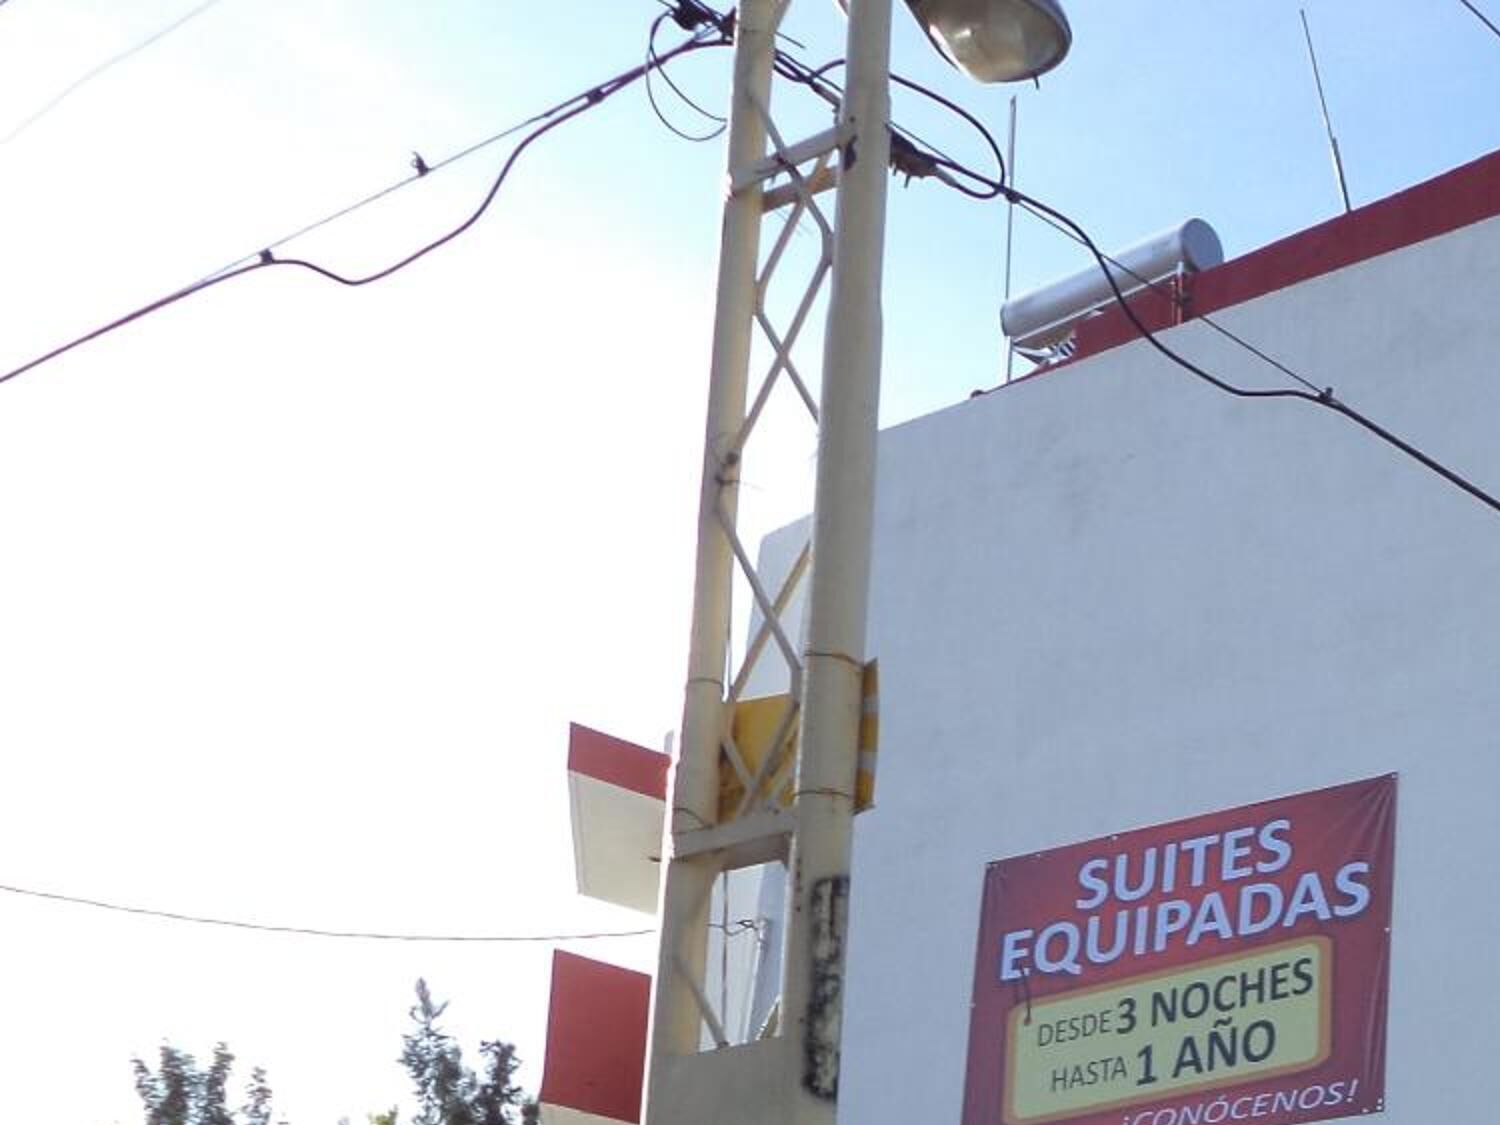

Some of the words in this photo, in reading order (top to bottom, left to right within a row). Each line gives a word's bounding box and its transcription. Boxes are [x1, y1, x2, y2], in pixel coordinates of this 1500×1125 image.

[1075, 819, 1293, 910] SUITES
[1000, 861, 1372, 981] EQUIPADAS
[1037, 1009, 1111, 1047] DESDE
[1115, 998, 1138, 1036] 3
[1150, 957, 1315, 1027] NOCHES
[1051, 1056, 1128, 1093] HASTA
[1136, 1046, 1157, 1087] 1
[1172, 1018, 1276, 1080] AÑO
